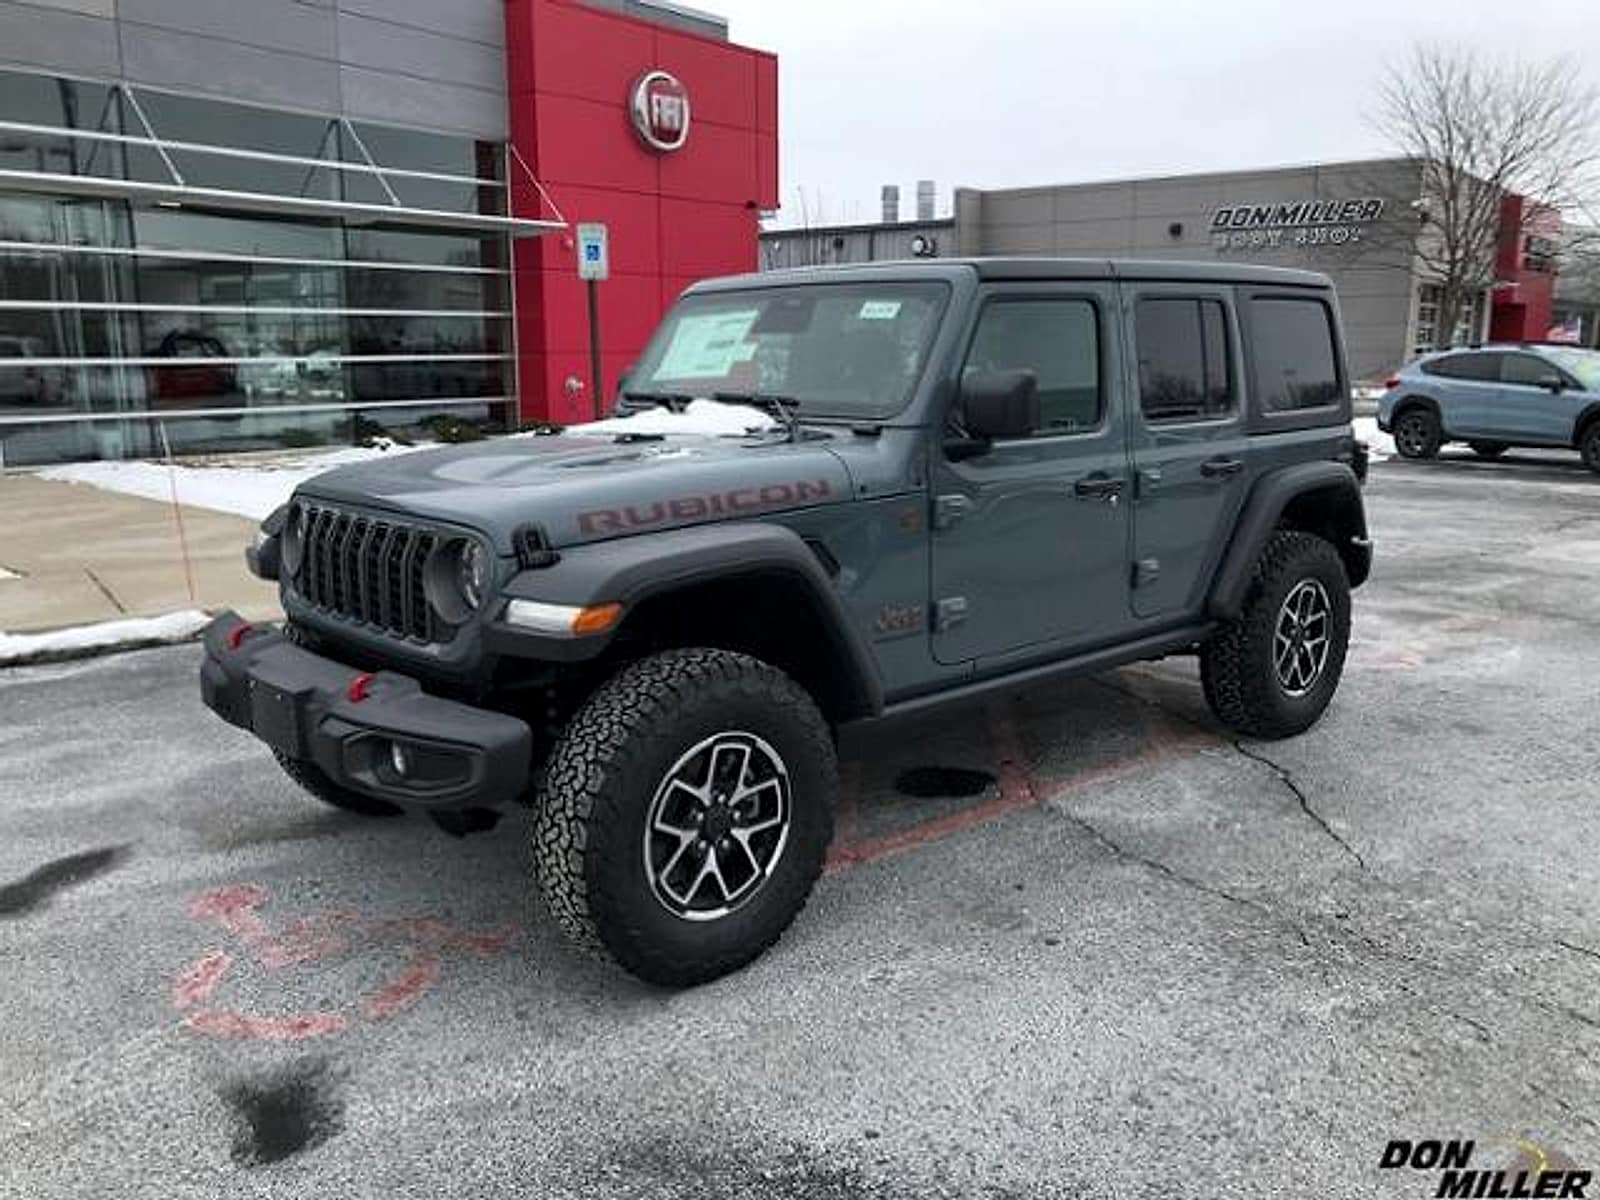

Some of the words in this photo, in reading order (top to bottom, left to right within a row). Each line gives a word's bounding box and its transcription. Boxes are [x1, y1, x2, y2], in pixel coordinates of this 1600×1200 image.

[1212, 207, 1272, 227] DON
[1276, 199, 1383, 224] MILLER
[577, 480, 832, 534] RUBICON
